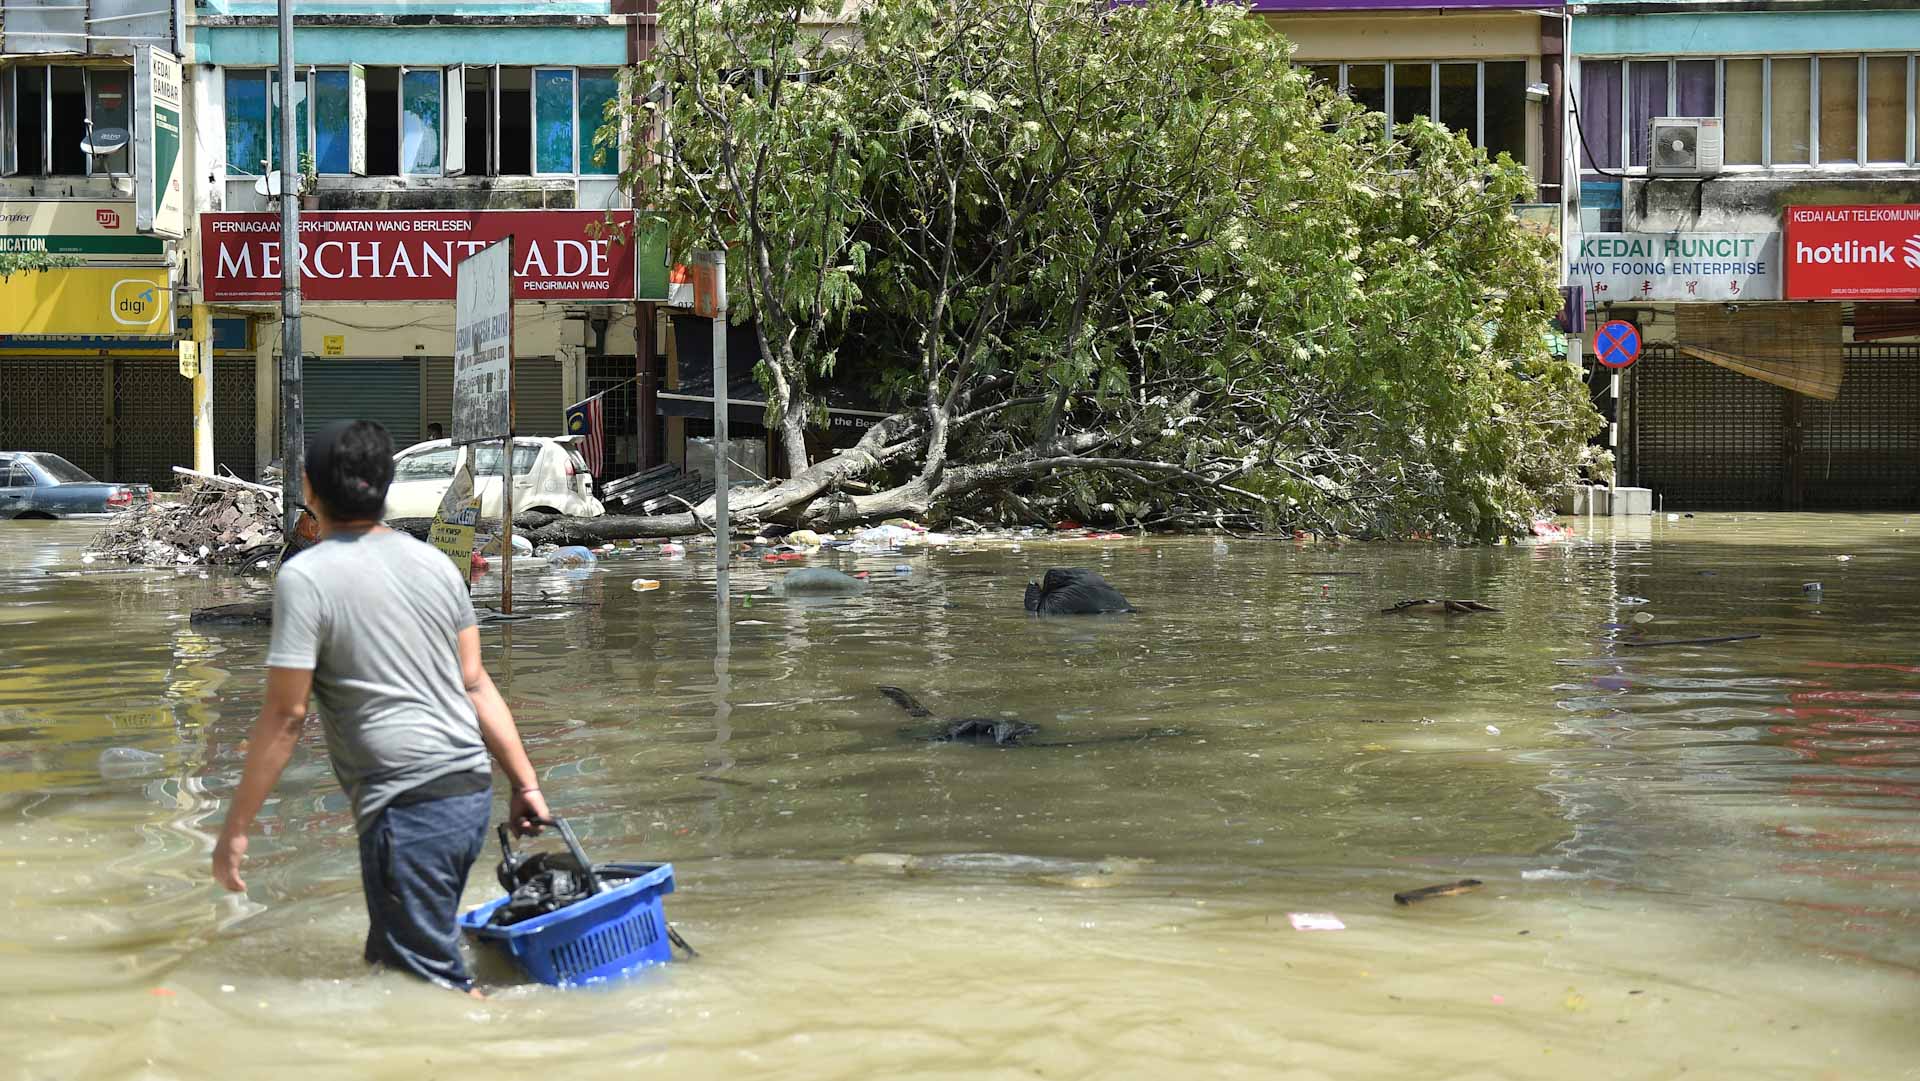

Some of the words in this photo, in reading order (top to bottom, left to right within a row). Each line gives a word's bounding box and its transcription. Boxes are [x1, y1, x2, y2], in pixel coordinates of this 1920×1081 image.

[152, 62, 171, 80] KEDAI
[153, 78, 179, 100] GAMBAR
[1794, 210, 1823, 222] KEDAI
[1826, 210, 1850, 222] ALAT
[298, 220, 374, 232] ERKHIDMATAN
[377, 220, 410, 232] WANG
[413, 220, 472, 231] BERLESEN
[1580, 239, 1652, 258] KEDAI
[1664, 239, 1755, 258] RUNCIT
[1796, 240, 1896, 264] hotlink
[215, 239, 610, 279] MERCHANTADE
[1570, 263, 1605, 275] HWO
[1612, 262, 1666, 275] FOONG
[1673, 262, 1766, 275] ENTERPRISE
[523, 281, 580, 291] PENGIRIMAN
[582, 281, 609, 290] WANG
[119, 298, 146, 314] digi
[834, 416, 852, 427] the
[855, 418, 882, 429] Bes
